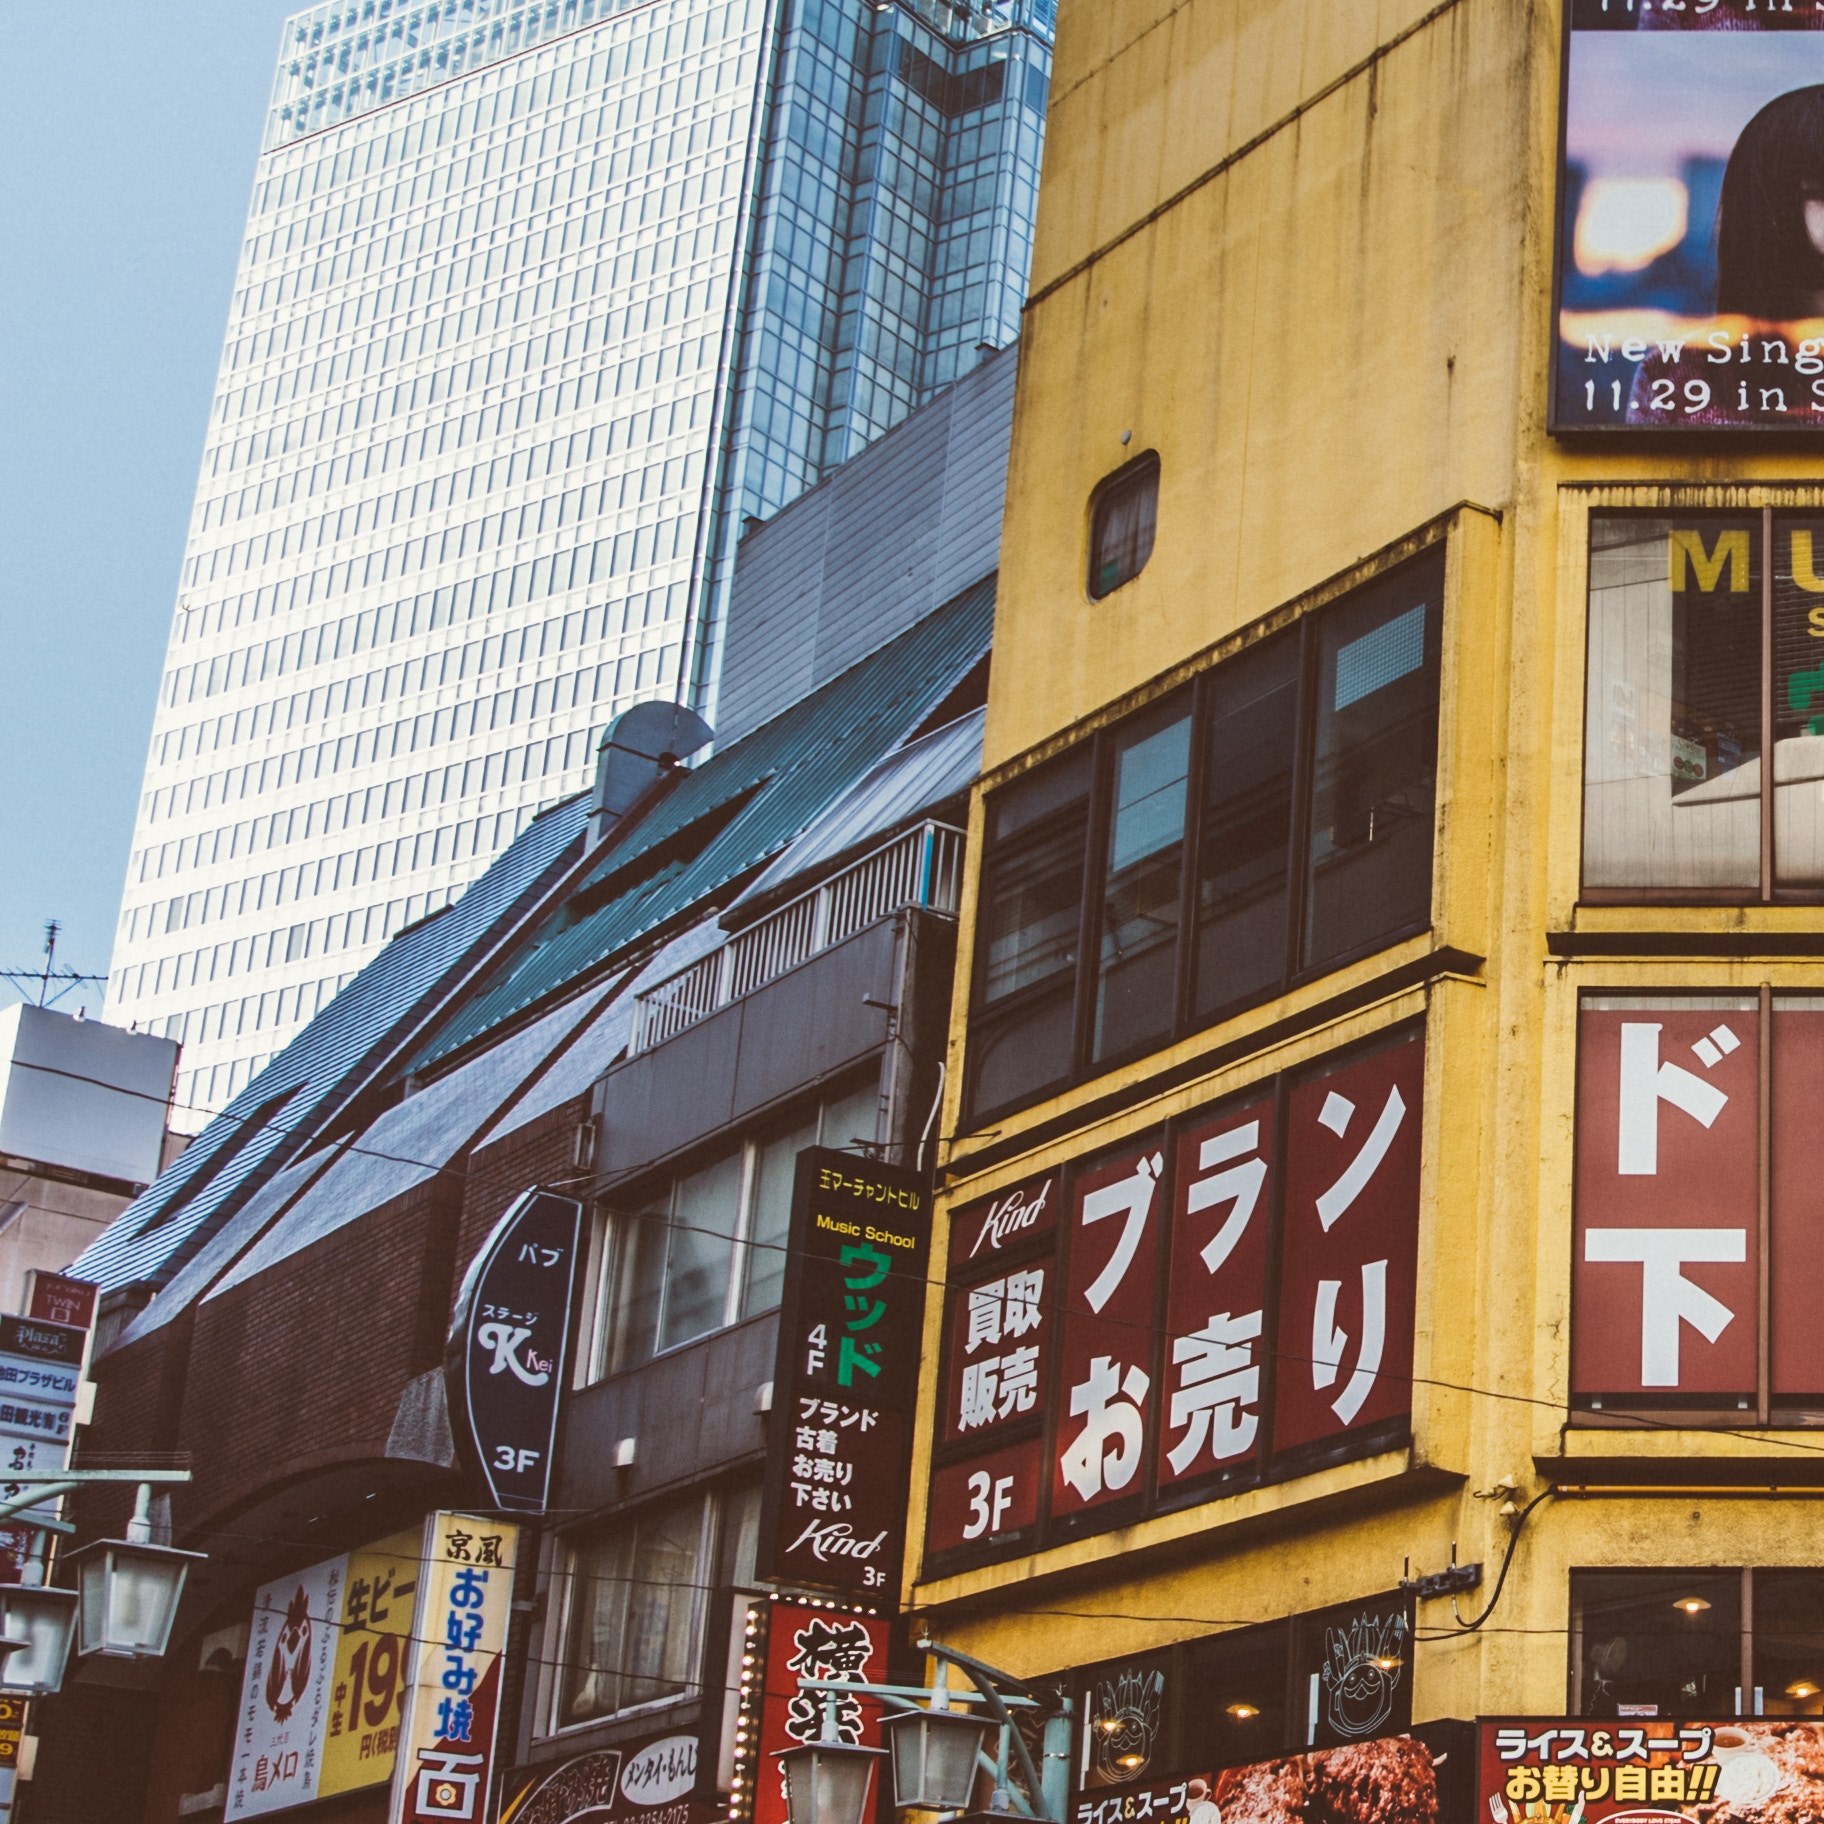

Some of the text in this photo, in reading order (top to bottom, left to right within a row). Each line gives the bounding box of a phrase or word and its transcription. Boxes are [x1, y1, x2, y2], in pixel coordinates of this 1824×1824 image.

[1584, 332, 1700, 365] New
[1583, 380, 1712, 413] 11.29
[1737, 380, 1787, 412] in
[816, 1213, 916, 1249] Music School
[969, 1178, 1053, 1260] Kind
[517, 1244, 564, 1269] パブ
[480, 1303, 541, 1325] ステージ
[837, 1241, 893, 1387] ウッド
[964, 1269, 1046, 1355] 買取
[806, 1323, 828, 1376] 4F
[957, 1345, 1041, 1435] 販売
[1060, 1258, 1390, 1504] お売り
[799, 1397, 879, 1432] ブランド
[795, 1426, 839, 1455] 古着
[493, 1446, 541, 1474] 3F
[791, 1453, 853, 1486] お売り
[790, 1481, 852, 1513] 下さい
[962, 1469, 1014, 1541] 3F
[444, 1528, 505, 1568] 京風
[784, 1518, 889, 1562] Kind
[863, 1565, 887, 1588] 3F
[433, 1567, 490, 1742] お好み焼
[1493, 1728, 1715, 1762] ライス&スープ
